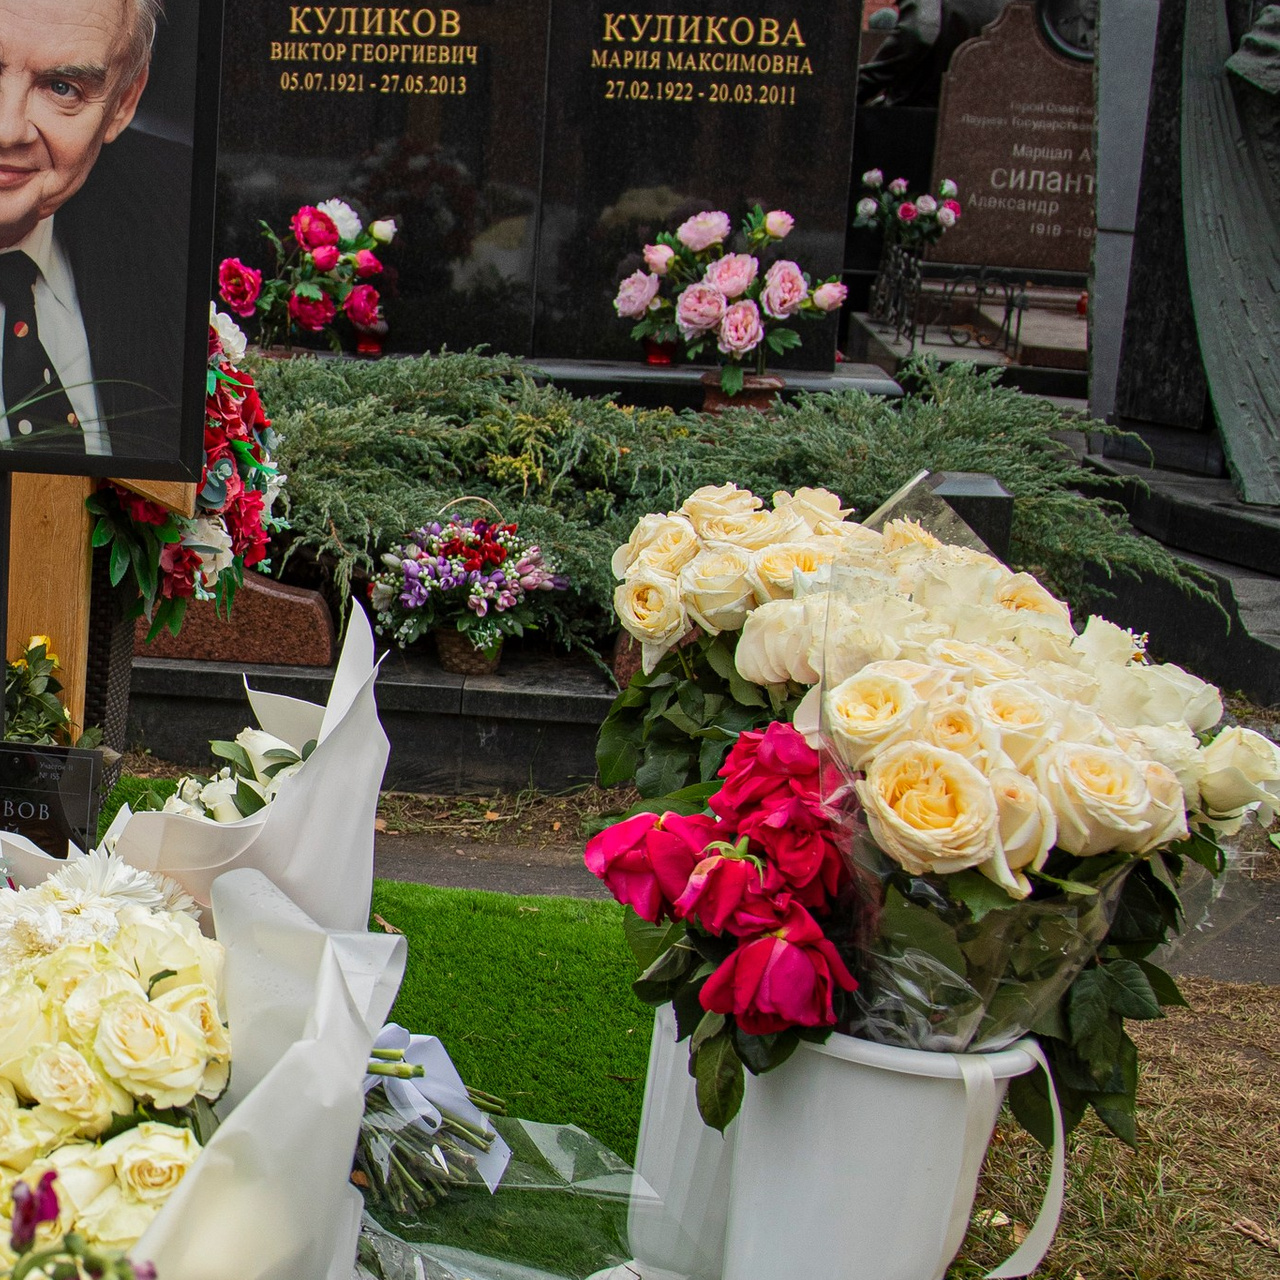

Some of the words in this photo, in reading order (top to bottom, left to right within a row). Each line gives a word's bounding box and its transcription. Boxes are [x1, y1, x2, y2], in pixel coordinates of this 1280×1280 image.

[288, 5, 461, 38] КУЛИКОВ
[601, 12, 807, 47] КУЛИКОВА
[270, 41, 347, 62] ВИКТОР
[351, 43, 478, 65] ГЕОРГИЕВИЧ
[590, 48, 661, 69] МАРИЯ
[666, 51, 814, 75] МАКСИМОВНА
[280, 71, 365, 93] 05.07.1921
[379, 73, 467, 95] 27.05.2013
[604, 79, 694, 101] 27.02.1922
[708, 83, 796, 106] 20.03.2011
[968, 193, 1060, 217] Александр
